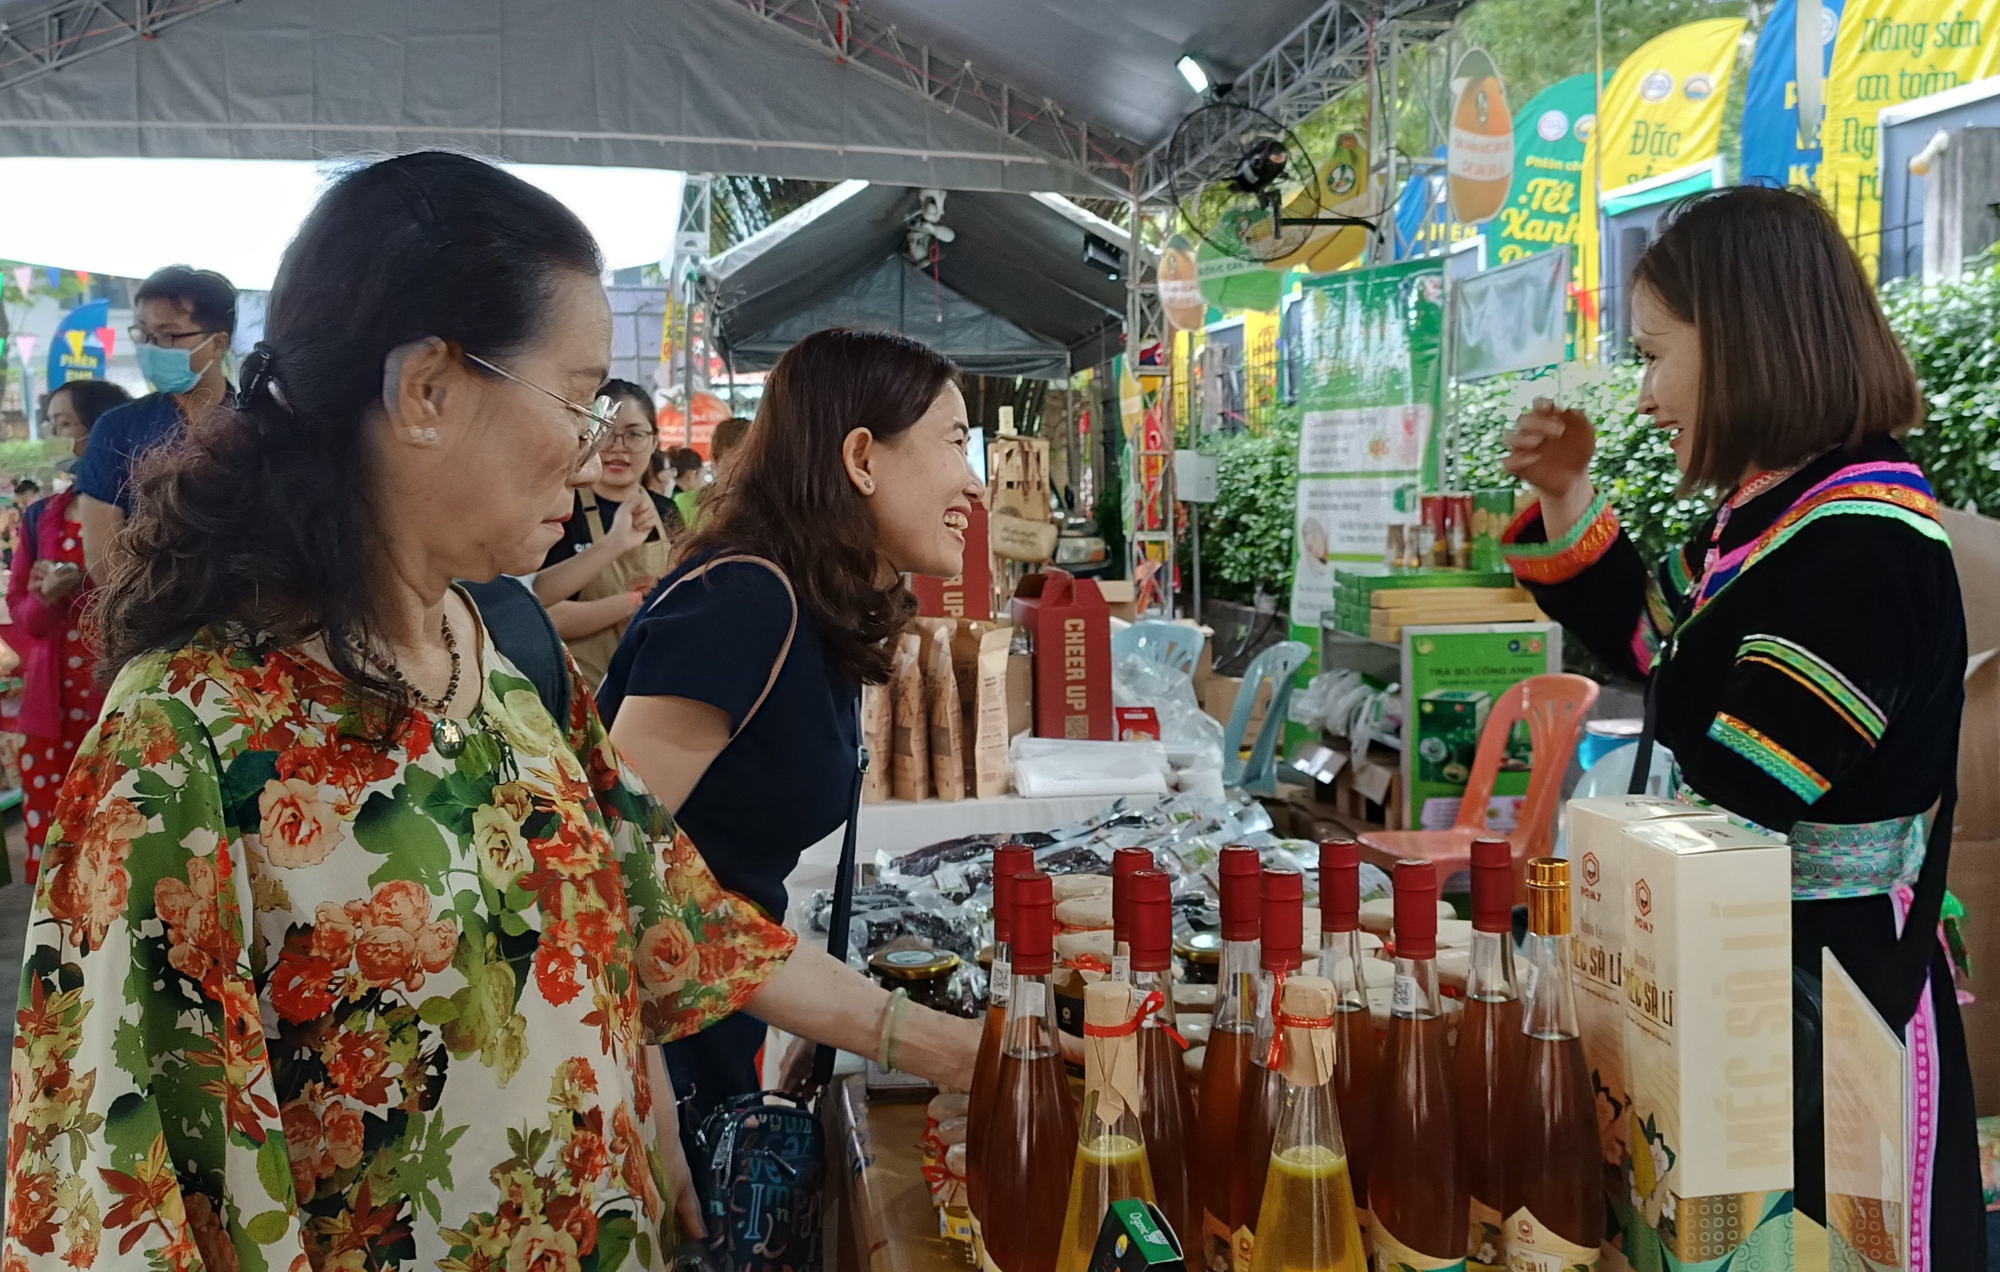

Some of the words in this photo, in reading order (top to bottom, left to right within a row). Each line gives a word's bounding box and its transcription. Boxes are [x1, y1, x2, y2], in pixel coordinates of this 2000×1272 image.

[1933, 11, 1982, 49] sản
[1857, 73, 1890, 101] an
[1628, 119, 1682, 162] Đặc
[1841, 117, 1878, 160] Ng
[1526, 176, 1576, 214] Tết
[1064, 618, 1087, 681] CHEER
[1065, 685, 1087, 711] UP
[1710, 900, 1791, 951] LÍ
[1711, 966, 1792, 1039] SÀ
[1712, 1054, 1793, 1171] MÉC
